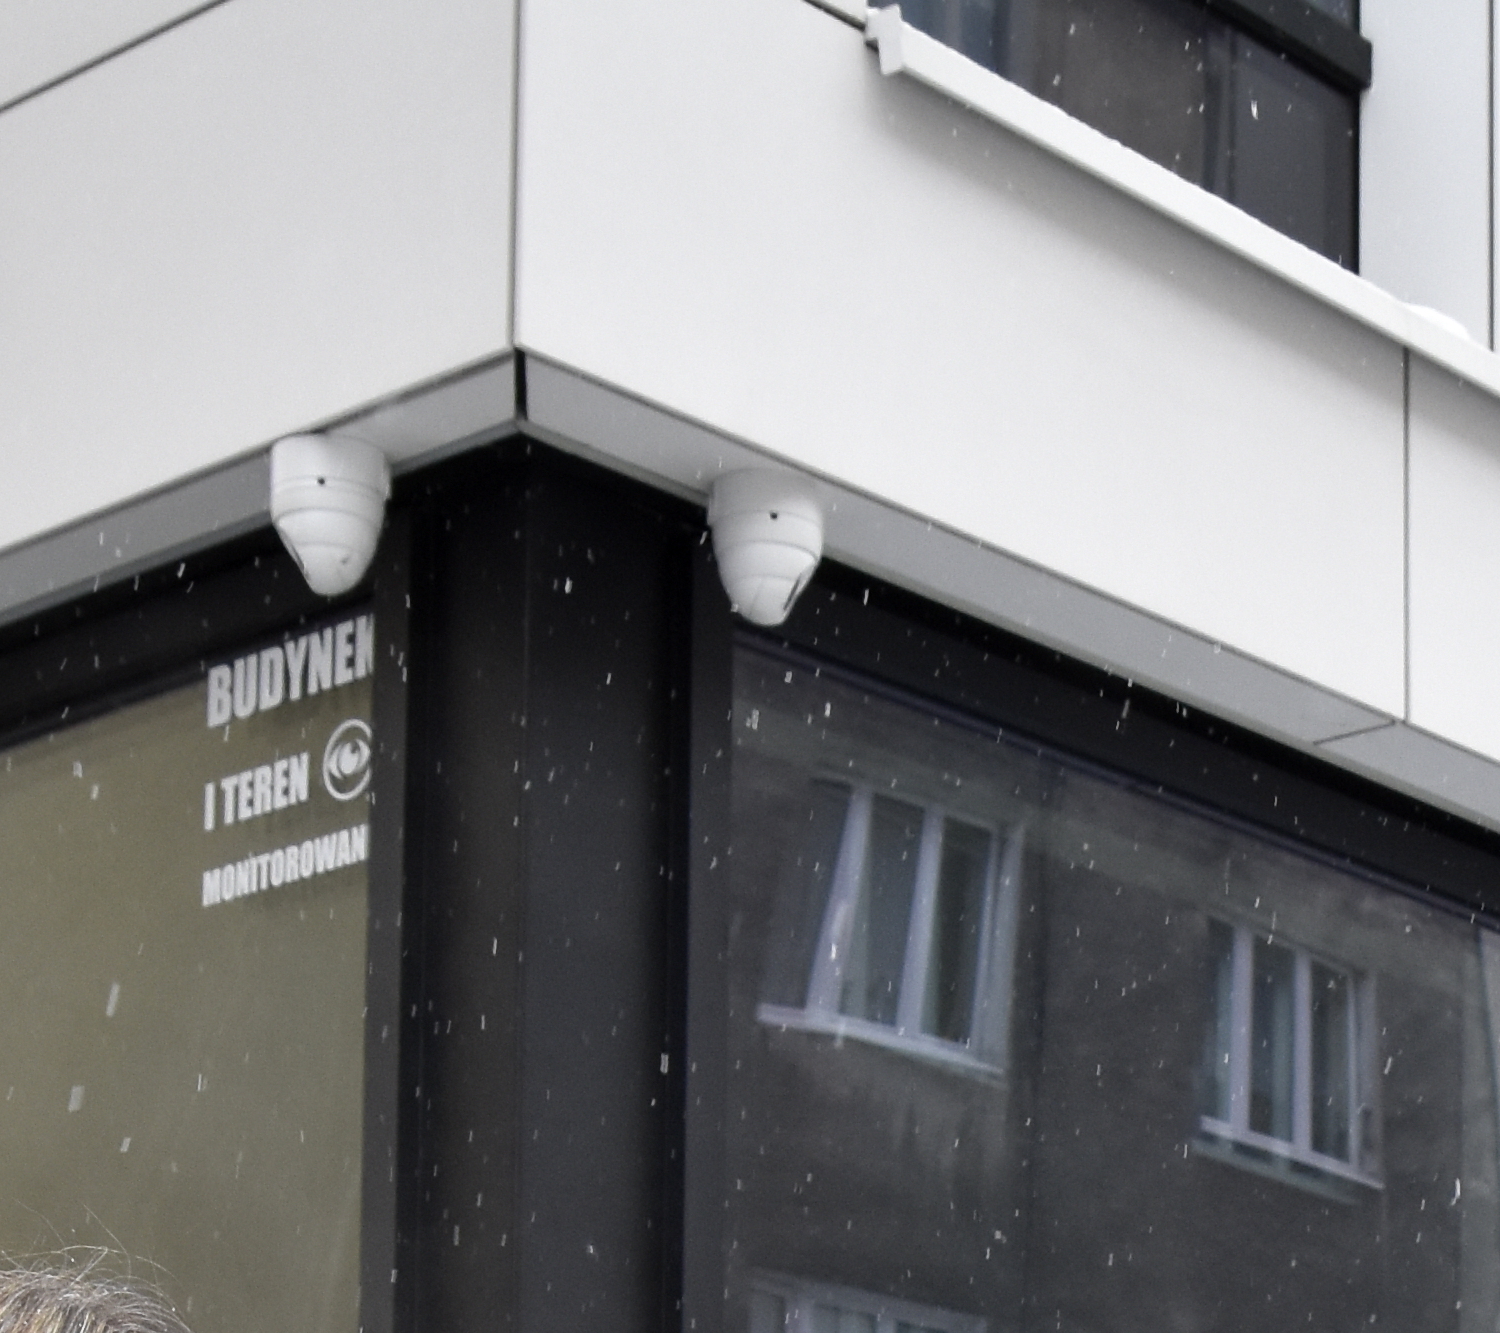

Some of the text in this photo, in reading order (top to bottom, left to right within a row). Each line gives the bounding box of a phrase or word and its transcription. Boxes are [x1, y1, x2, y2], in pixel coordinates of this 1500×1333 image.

[207, 613, 375, 728] BUDYNEK
[204, 752, 311, 830] I TEREN
[202, 823, 369, 907] MONITOROWAN
